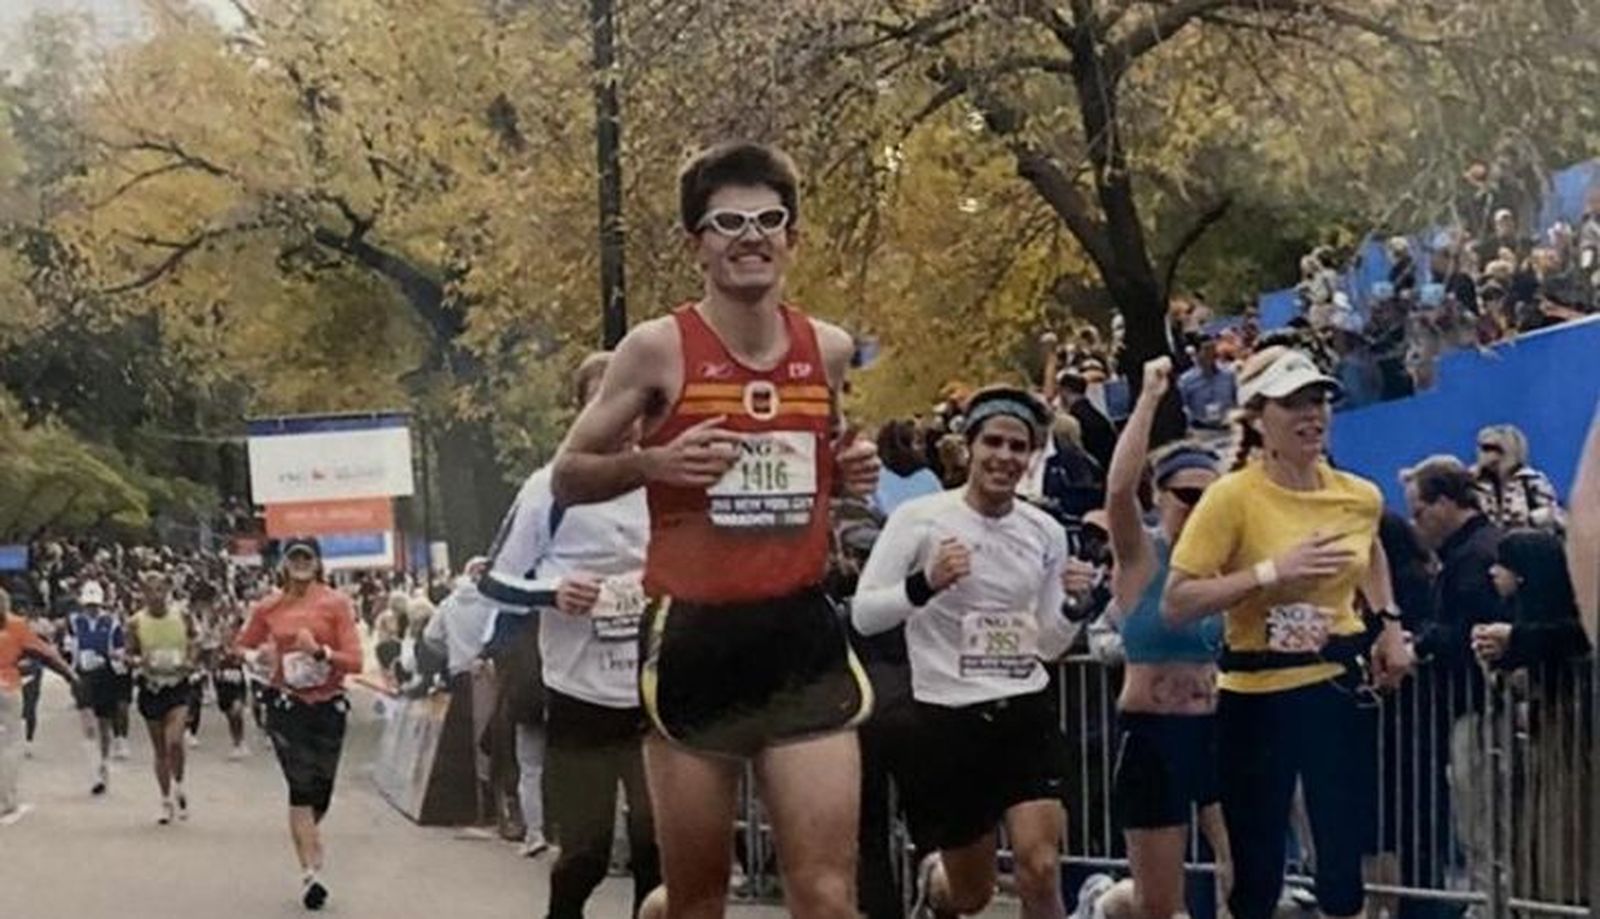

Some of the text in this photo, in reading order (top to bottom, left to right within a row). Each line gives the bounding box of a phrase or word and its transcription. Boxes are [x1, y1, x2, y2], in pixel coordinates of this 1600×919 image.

[788, 362, 812, 378] ESP
[735, 438, 773, 457] NG
[741, 460, 788, 491] 1416
